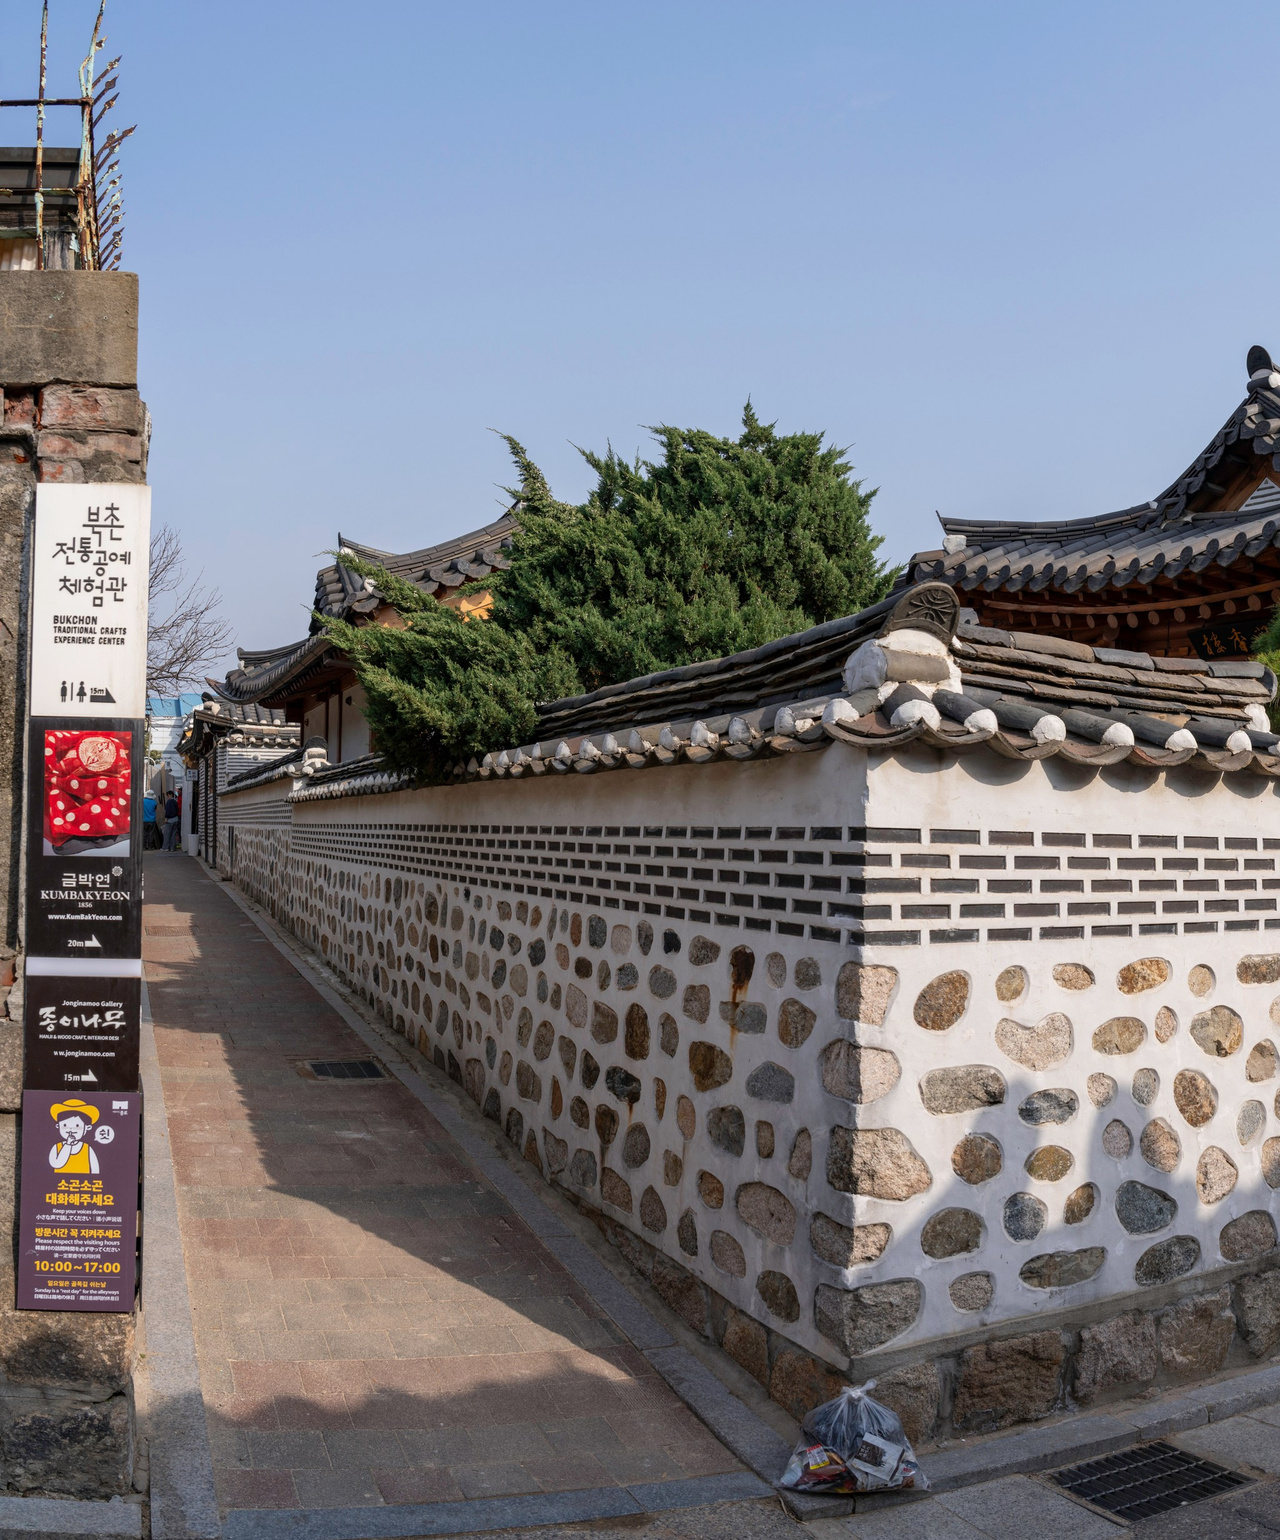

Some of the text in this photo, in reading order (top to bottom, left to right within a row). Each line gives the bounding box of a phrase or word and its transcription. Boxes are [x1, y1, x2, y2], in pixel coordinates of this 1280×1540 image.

[82, 502, 124, 546] 북촌
[52, 537, 131, 576] 전통공예
[59, 576, 127, 607] 체험관
[53, 615, 98, 626] BUKCHON
[53, 626, 127, 636] TRADITIONAL CRAFTS
[54, 636, 125, 645] EXPERIENCE CENTER
[62, 872, 110, 888] 금박연
[40, 890, 130, 901] KUMBAKYEON
[68, 939, 84, 947] 20m
[62, 1000, 100, 1008] Jonginamoo
[39, 1006, 126, 1032] 종이나무
[64, 1074, 80, 1082] 15m
[99, 1129, 110, 1140] 쉿
[57, 1179, 103, 1192] 소곤소곤
[46, 1193, 114, 1206] 대화해주세요
[35, 1228, 121, 1238] 방문시간 꼭 지켜주세요
